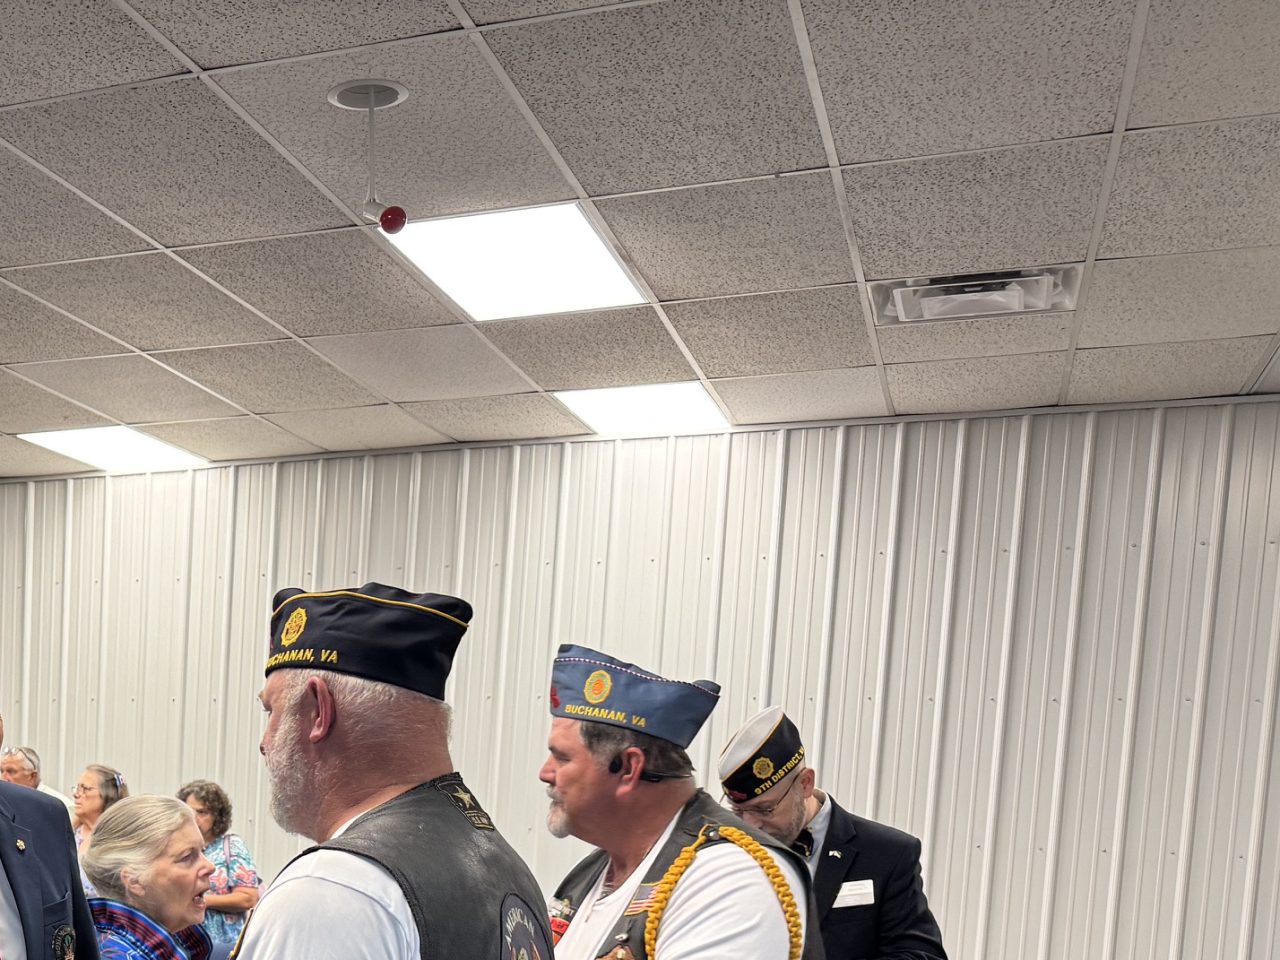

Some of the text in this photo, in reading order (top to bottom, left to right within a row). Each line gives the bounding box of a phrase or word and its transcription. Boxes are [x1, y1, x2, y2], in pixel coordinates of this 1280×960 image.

[321, 649, 338, 664] VA
[565, 704, 647, 728] BUCHANAN, VA
